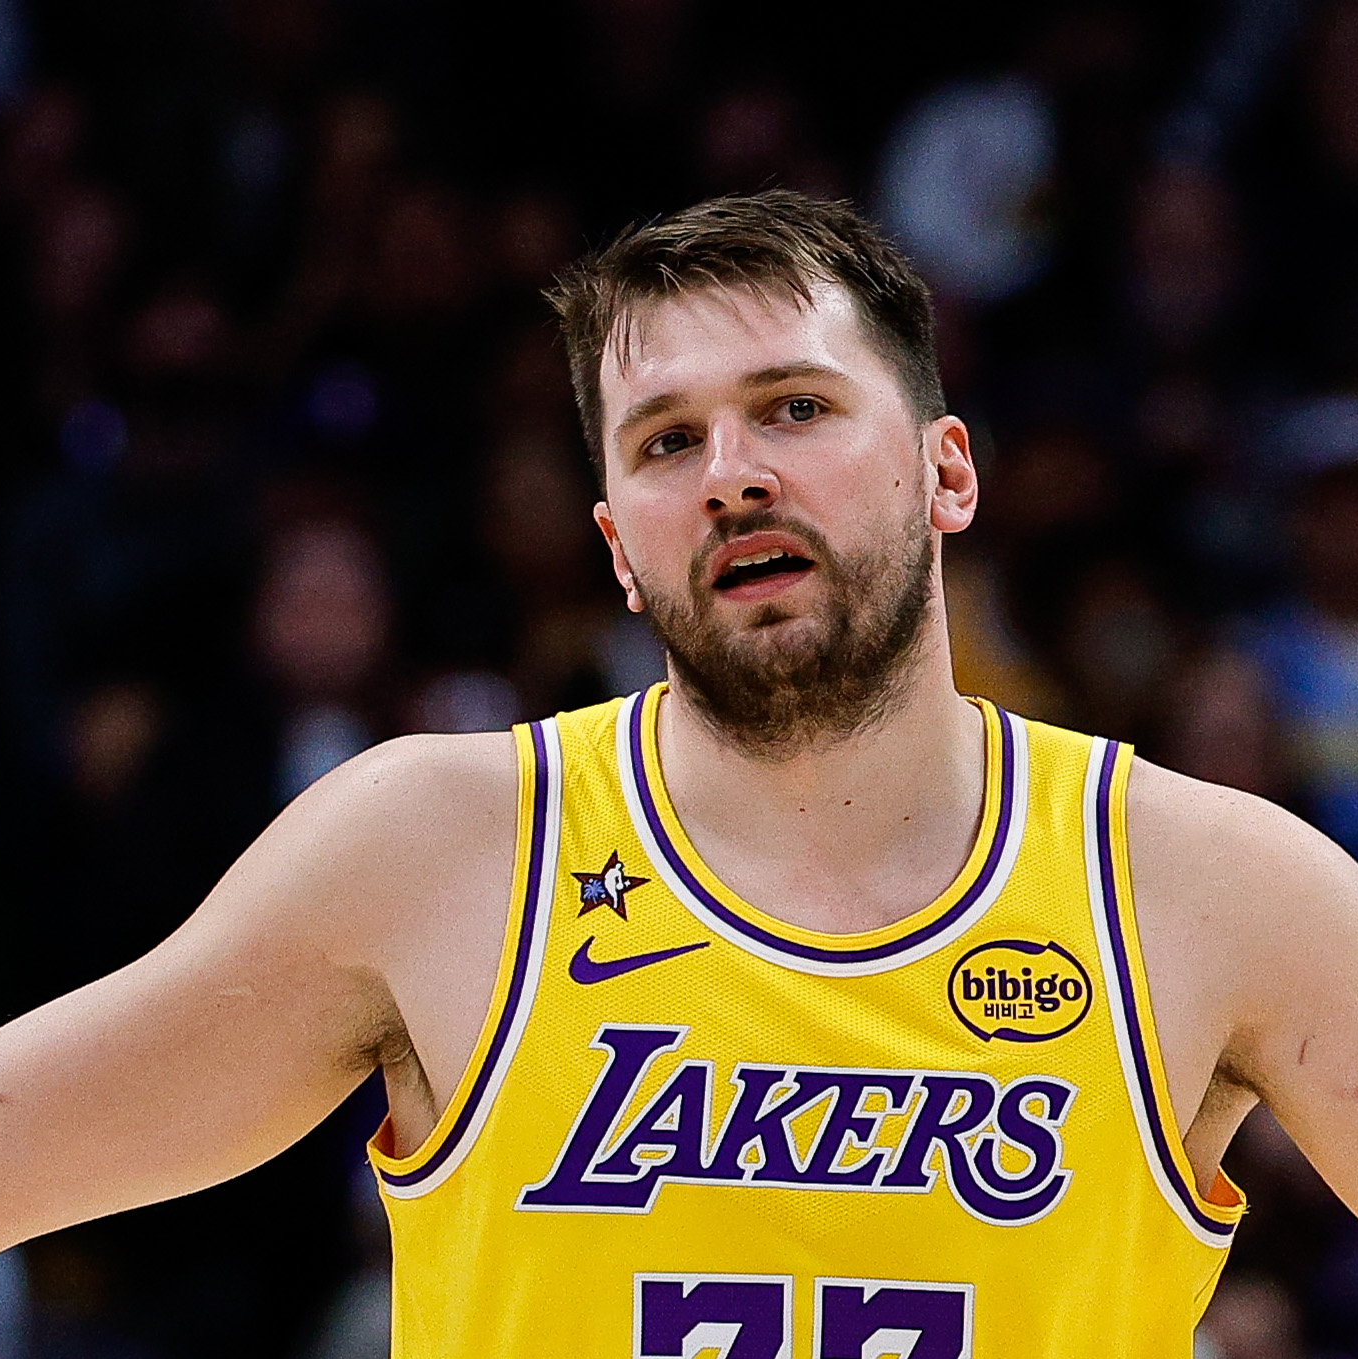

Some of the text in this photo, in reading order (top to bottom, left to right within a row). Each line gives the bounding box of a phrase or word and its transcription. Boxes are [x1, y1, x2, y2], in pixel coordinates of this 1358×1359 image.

[961, 967, 1083, 1012] bibigo
[984, 1003, 1035, 1020] 비비고
[514, 1023, 1081, 1227] LAKERS
